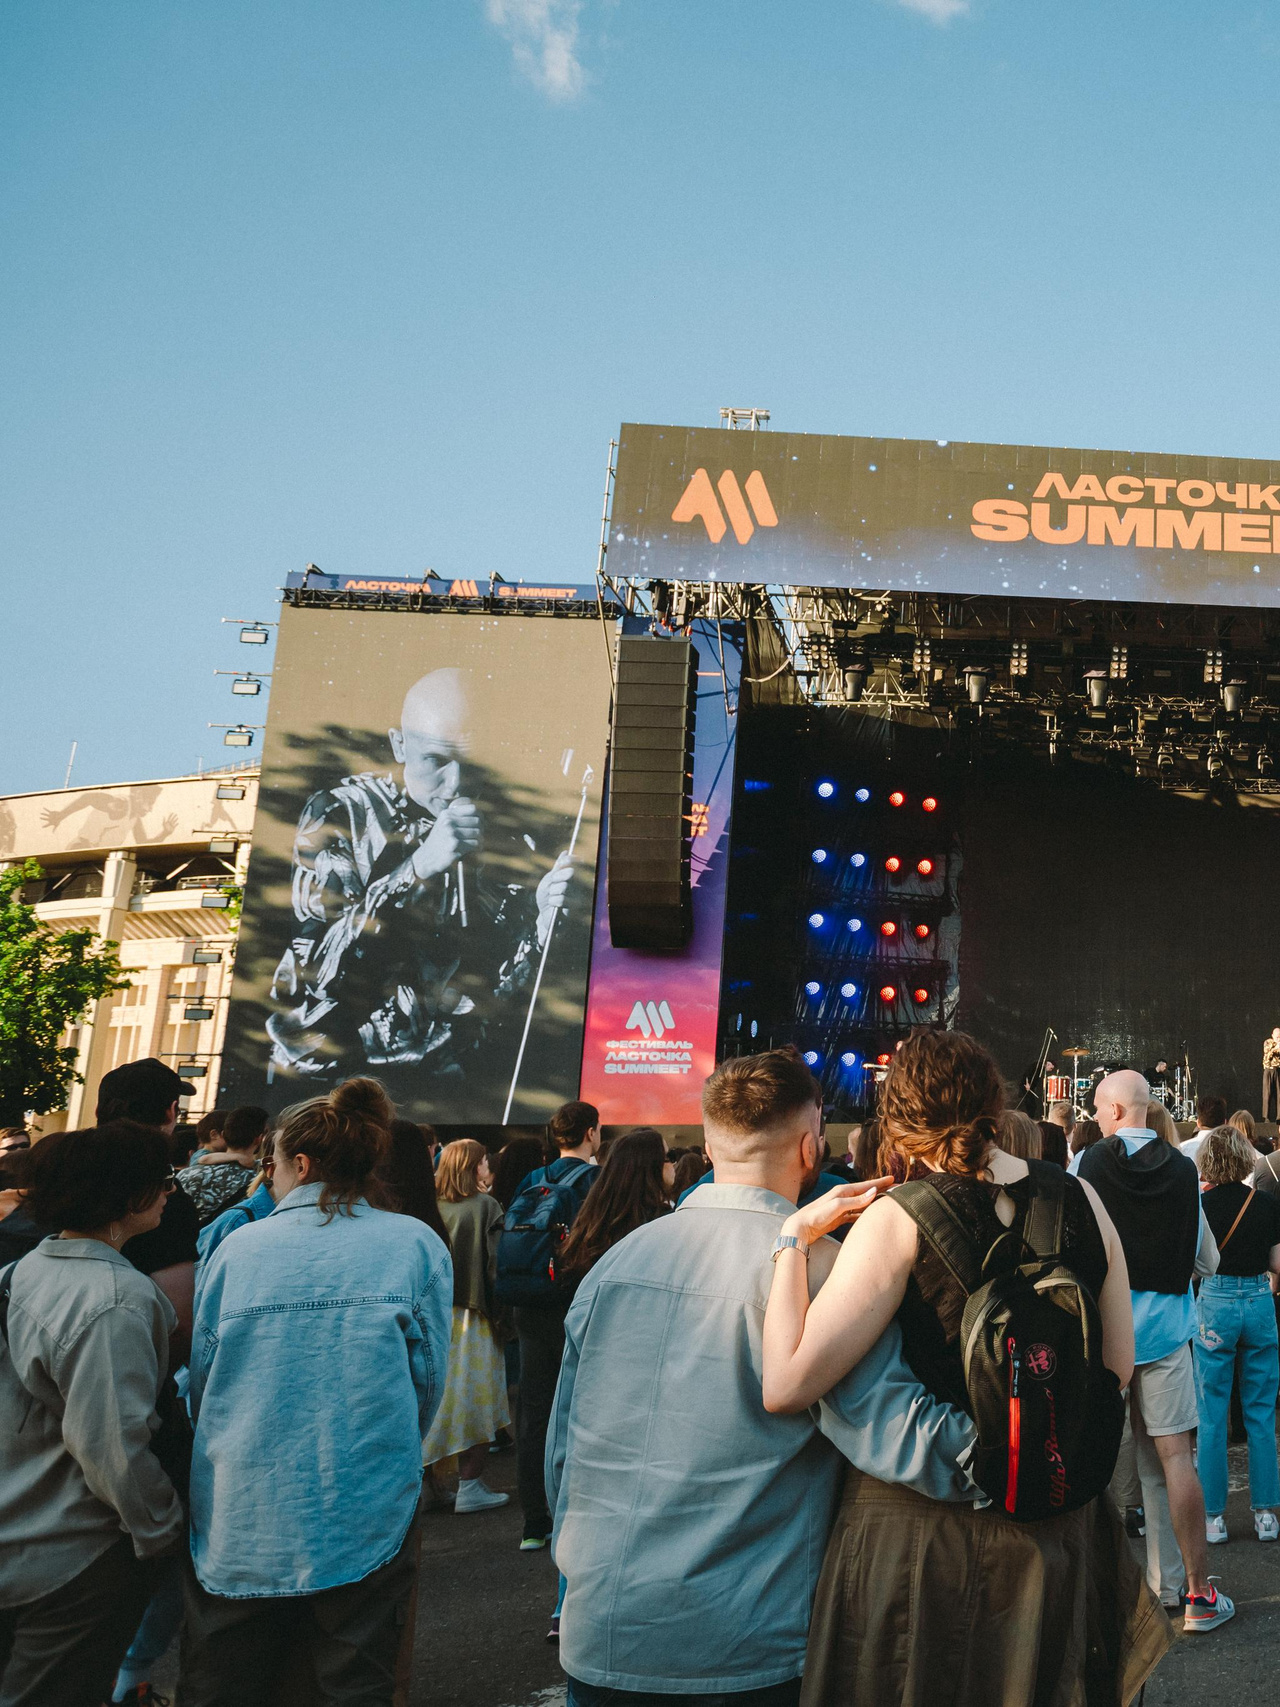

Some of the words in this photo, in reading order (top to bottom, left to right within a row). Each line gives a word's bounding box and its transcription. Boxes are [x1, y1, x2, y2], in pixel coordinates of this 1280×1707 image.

[344, 580, 432, 594] ЛАСТОЧКА
[498, 586, 578, 598] SUMMEET
[606, 1040, 693, 1049] ФЕСТИВАЛЬ
[605, 1051, 692, 1061] ЛАСТОЧКА
[604, 1063, 692, 1074] SUMMEET
